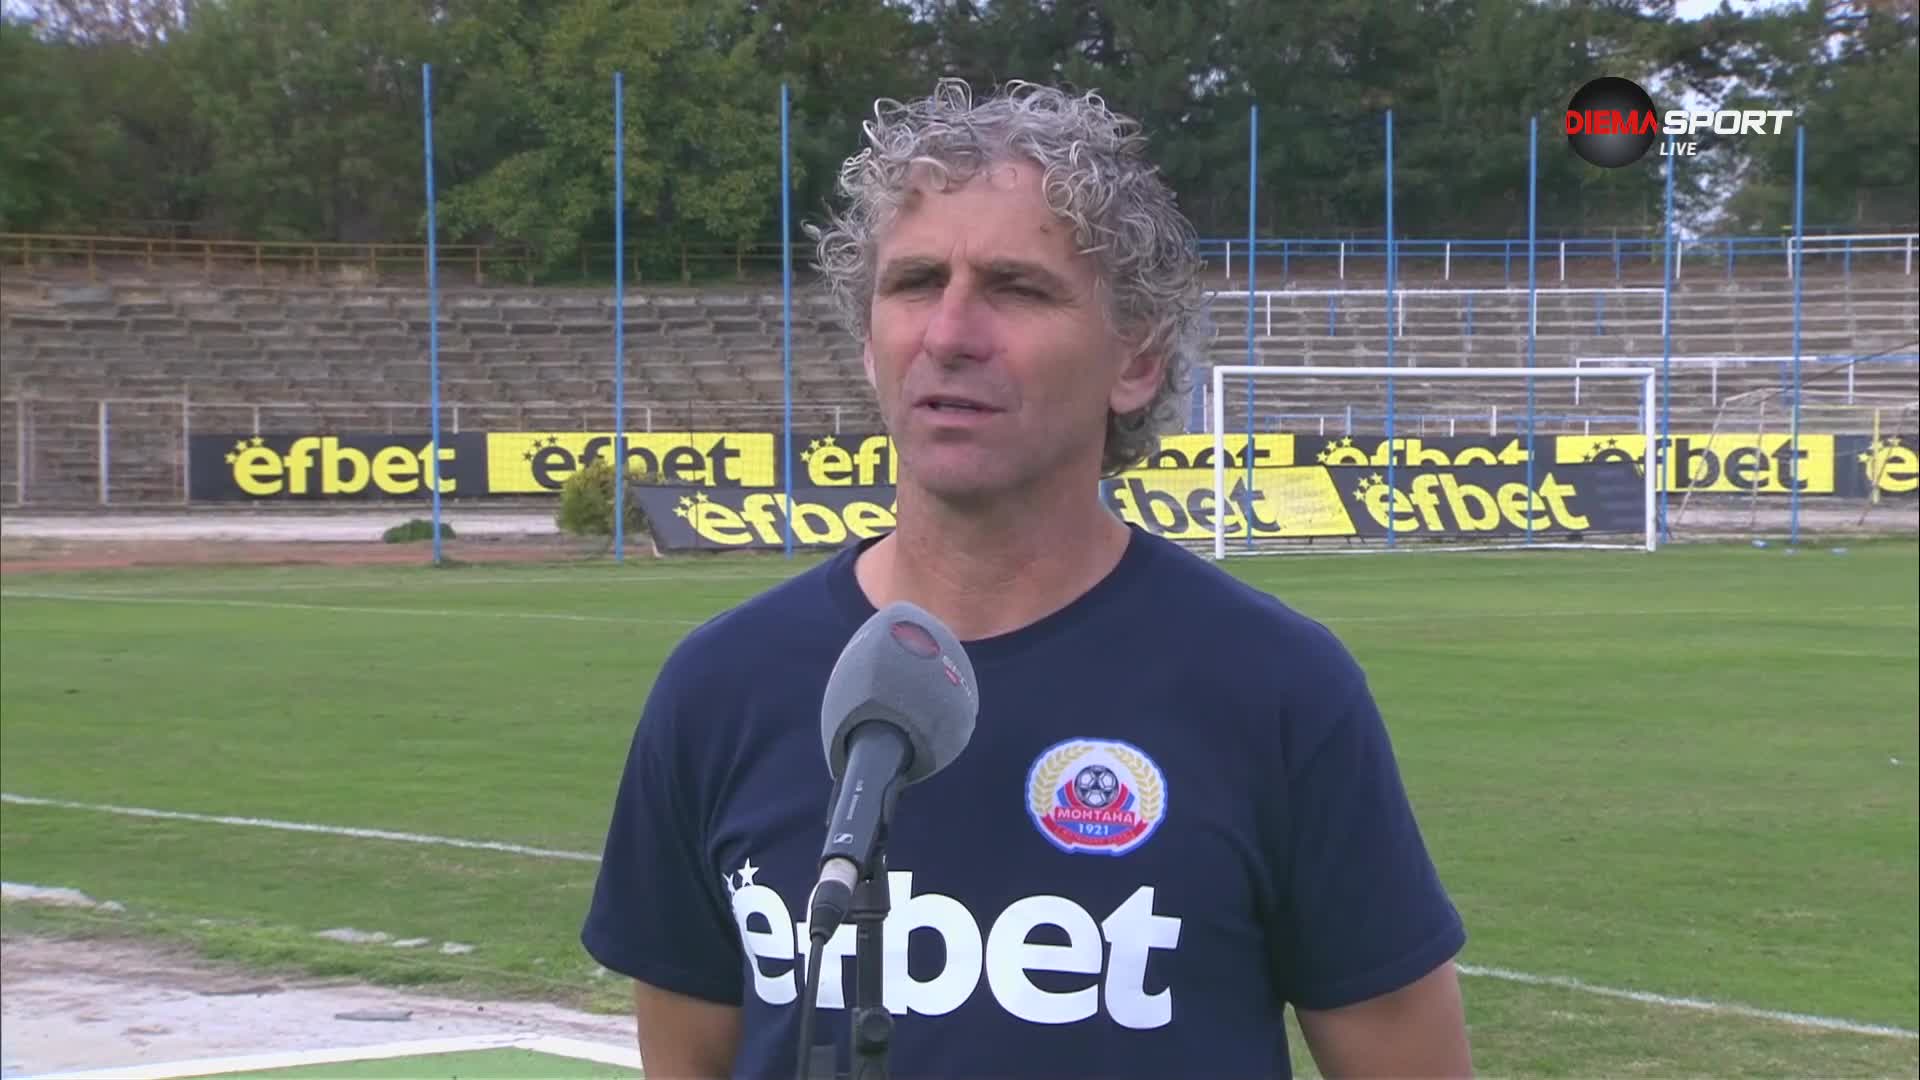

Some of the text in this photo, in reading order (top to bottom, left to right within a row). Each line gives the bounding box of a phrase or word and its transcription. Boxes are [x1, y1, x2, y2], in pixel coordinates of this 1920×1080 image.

[232, 436, 457, 495] efbet
[807, 435, 898, 487] ef
[687, 492, 898, 545] efbe
[1365, 472, 1591, 532] efbet
[1056, 807, 1134, 824] МОНТАНА
[1079, 823, 1109, 836] 1921
